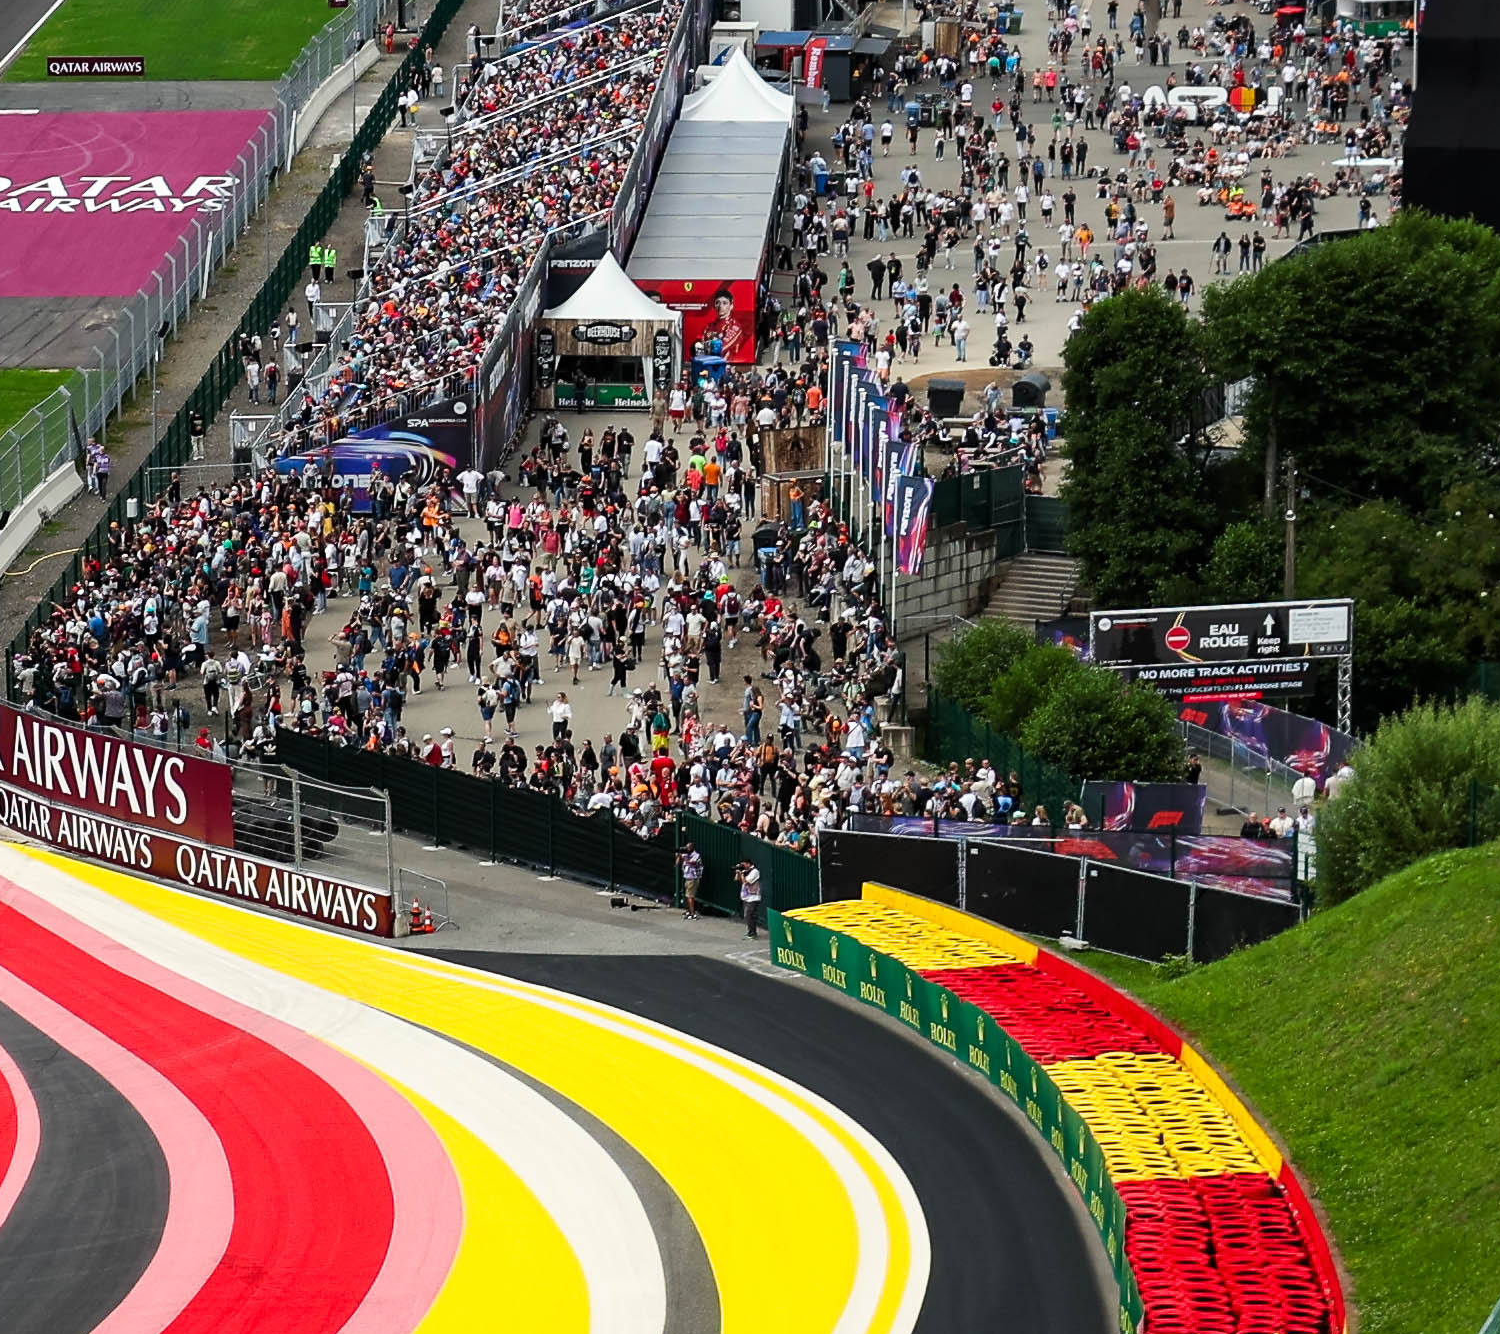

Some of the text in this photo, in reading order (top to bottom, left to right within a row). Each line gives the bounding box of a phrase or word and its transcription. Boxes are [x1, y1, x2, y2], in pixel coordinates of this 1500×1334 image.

[49, 61, 142, 75] QATAR AIRWAYS
[407, 418, 429, 428] SPA
[1209, 624, 1239, 635] EAU
[1200, 635, 1249, 649] ROUGE
[1257, 636, 1281, 648] Keep
[1257, 644, 1280, 655] right
[1139, 662, 1309, 680] NO MORE TRACK ACTIVITIES ?
[1280, 680, 1303, 689] STAGE
[12, 713, 188, 827] AIRWAYS
[57, 813, 153, 869] AIRWAYS
[176, 843, 378, 931] QATAR AIRWAYS
[777, 947, 807, 972] ROLEX
[822, 963, 847, 990] ROLEX
[860, 981, 886, 1009] ROLEX
[930, 1022, 957, 1052] ROLEX
